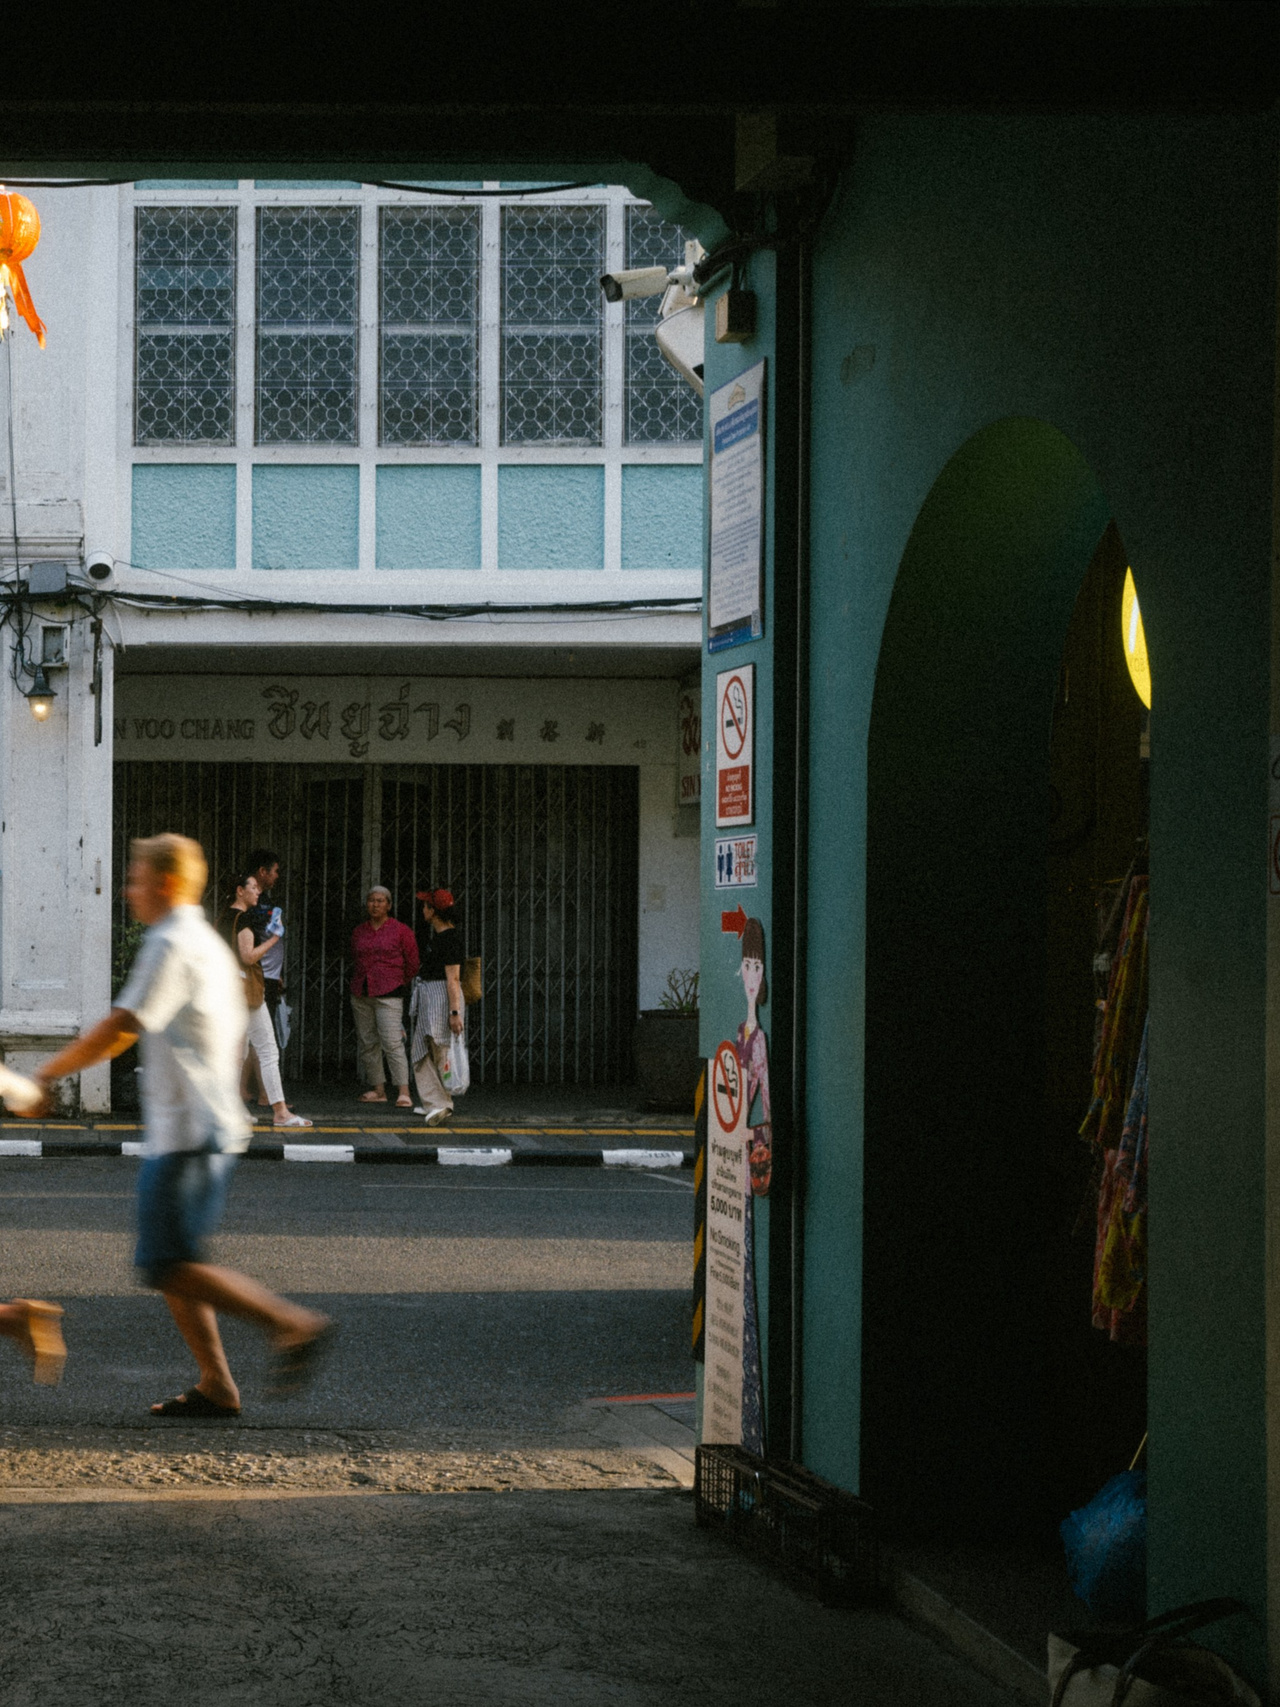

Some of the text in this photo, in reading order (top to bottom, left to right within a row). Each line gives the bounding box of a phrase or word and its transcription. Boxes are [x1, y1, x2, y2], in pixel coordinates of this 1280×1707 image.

[132, 718, 176, 740] YOO
[180, 718, 255, 741] CHANG
[734, 840, 755, 859] TOILET
[710, 1195, 742, 1222] 5,000 บาท
